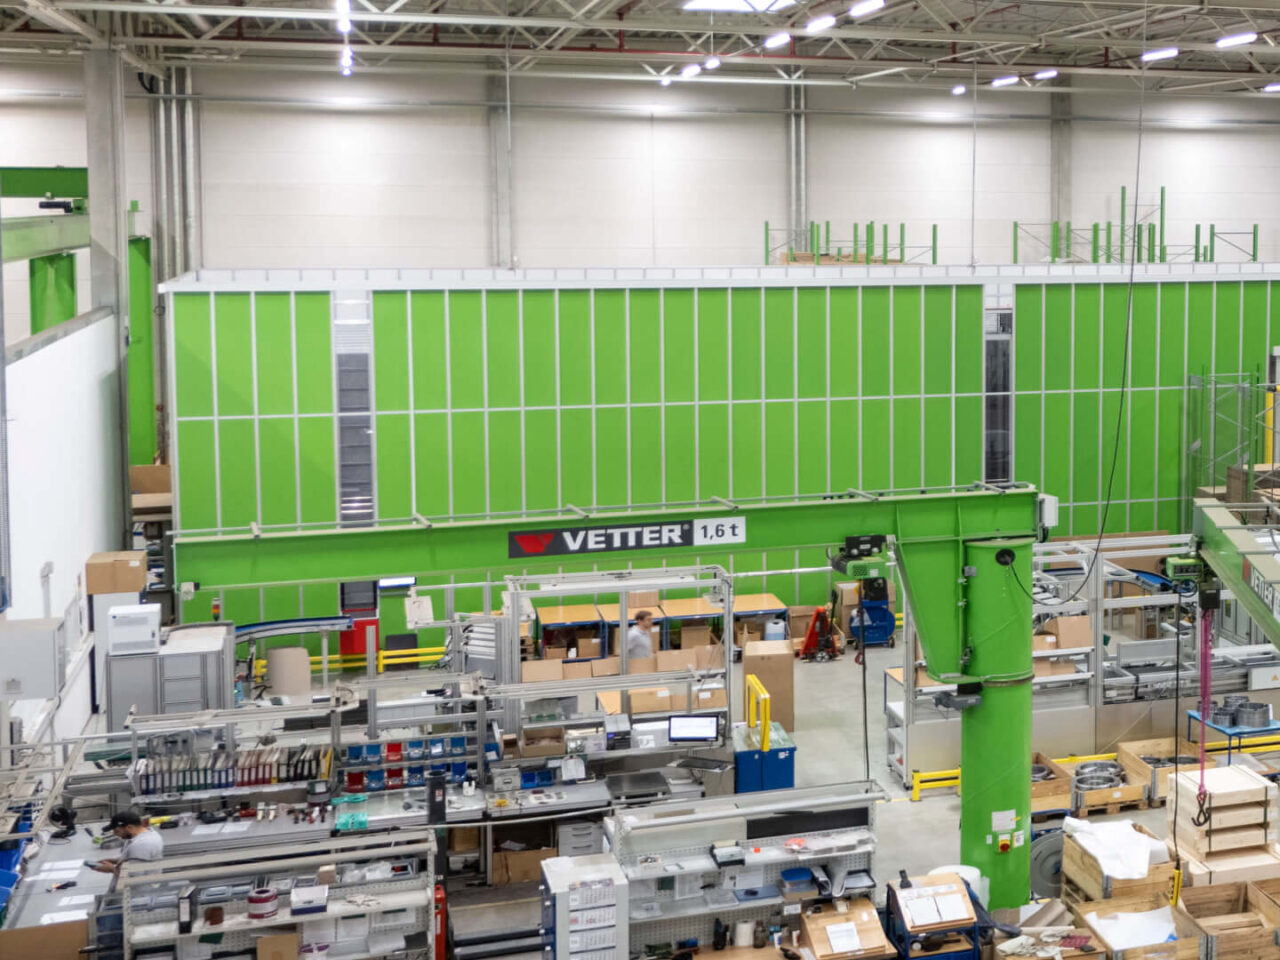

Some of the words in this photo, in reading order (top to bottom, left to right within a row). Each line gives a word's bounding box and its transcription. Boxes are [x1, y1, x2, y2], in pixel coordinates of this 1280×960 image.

[562, 524, 683, 551] VETTER
[700, 524, 725, 541] 1,6
[729, 523, 738, 537] t
